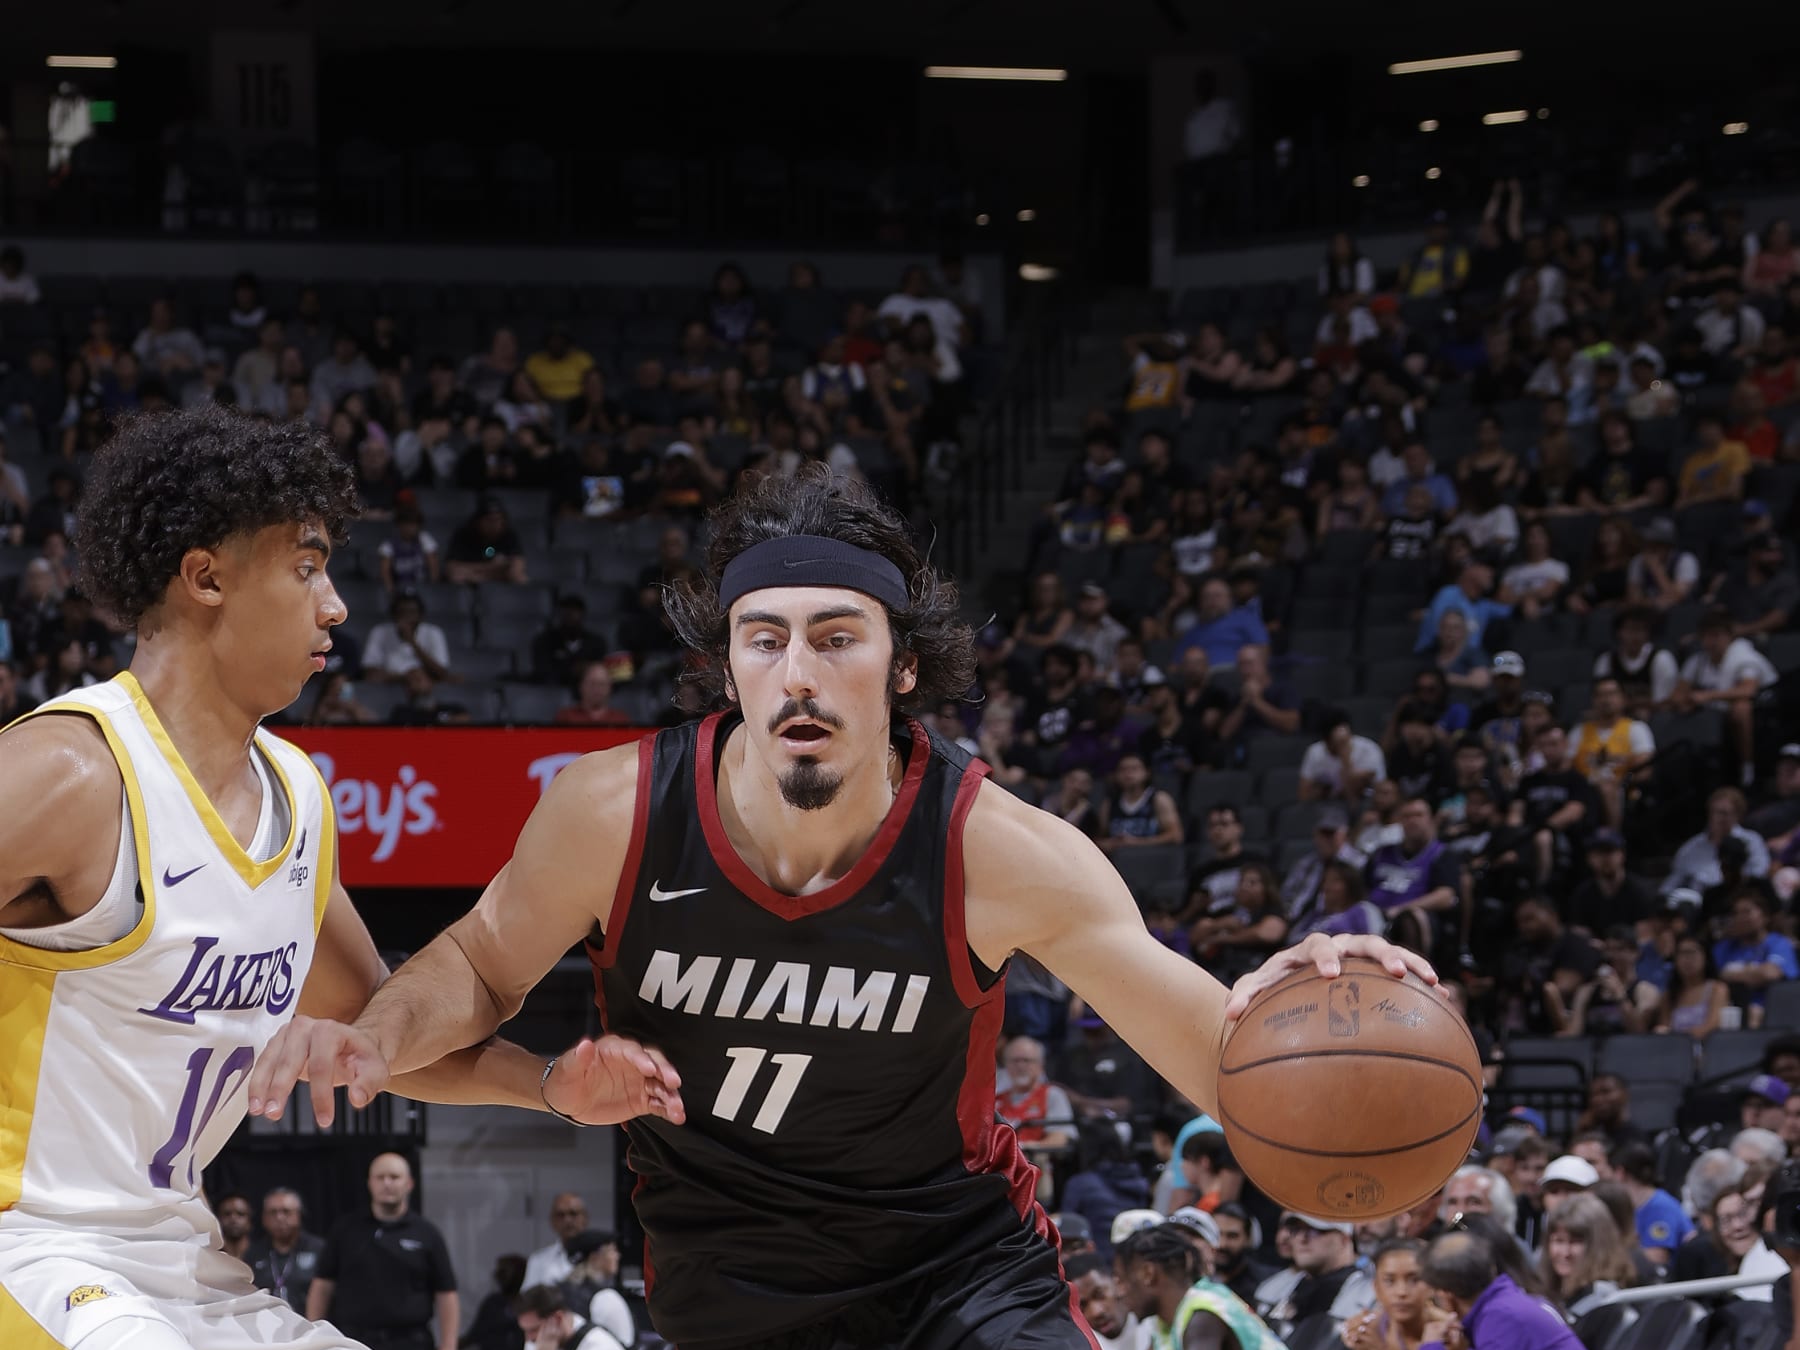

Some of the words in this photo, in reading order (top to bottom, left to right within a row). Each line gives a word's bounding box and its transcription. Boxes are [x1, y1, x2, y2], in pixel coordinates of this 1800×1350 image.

[137, 936, 297, 1025] LAKERS
[638, 949, 931, 1033] MIAMI
[711, 1047, 813, 1135] 11
